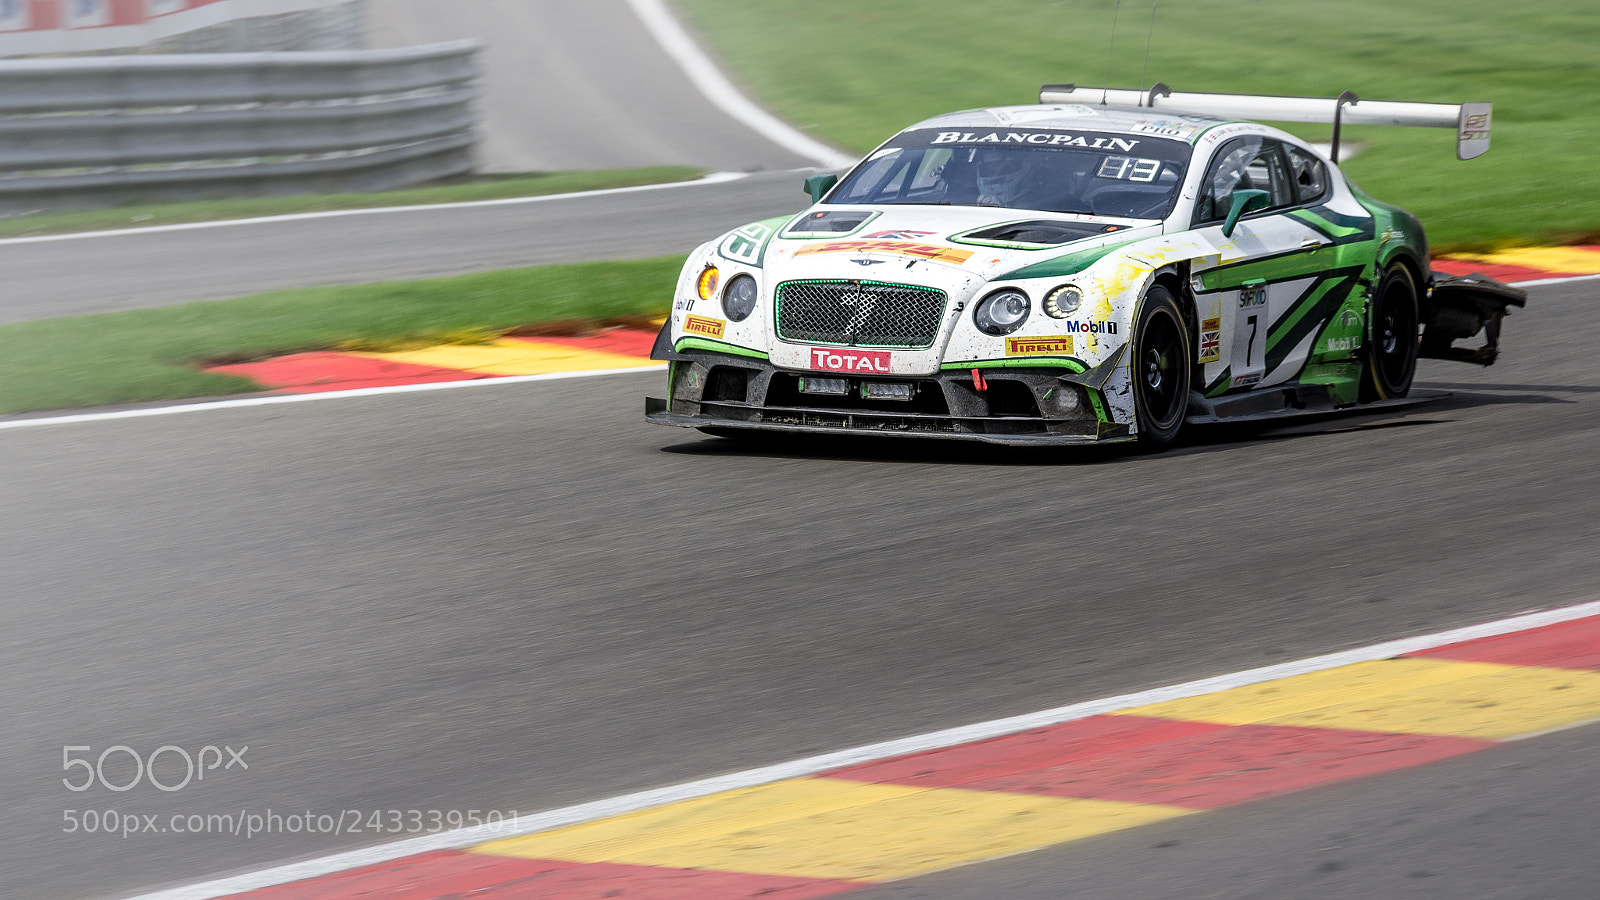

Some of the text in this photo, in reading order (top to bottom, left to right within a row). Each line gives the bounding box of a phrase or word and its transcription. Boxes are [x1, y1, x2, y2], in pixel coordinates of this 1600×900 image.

[1140, 125, 1180, 136] PRO
[930, 130, 1141, 153] BLANCPAIN
[816, 240, 944, 257] DHL
[685, 316, 724, 336] PIRELLI
[1066, 320, 1118, 335] Mobil 1
[1009, 338, 1068, 353] PIRELLI
[1246, 314, 1258, 368] 7
[1327, 336, 1351, 352] Mobil
[812, 350, 889, 373] TOTAL
